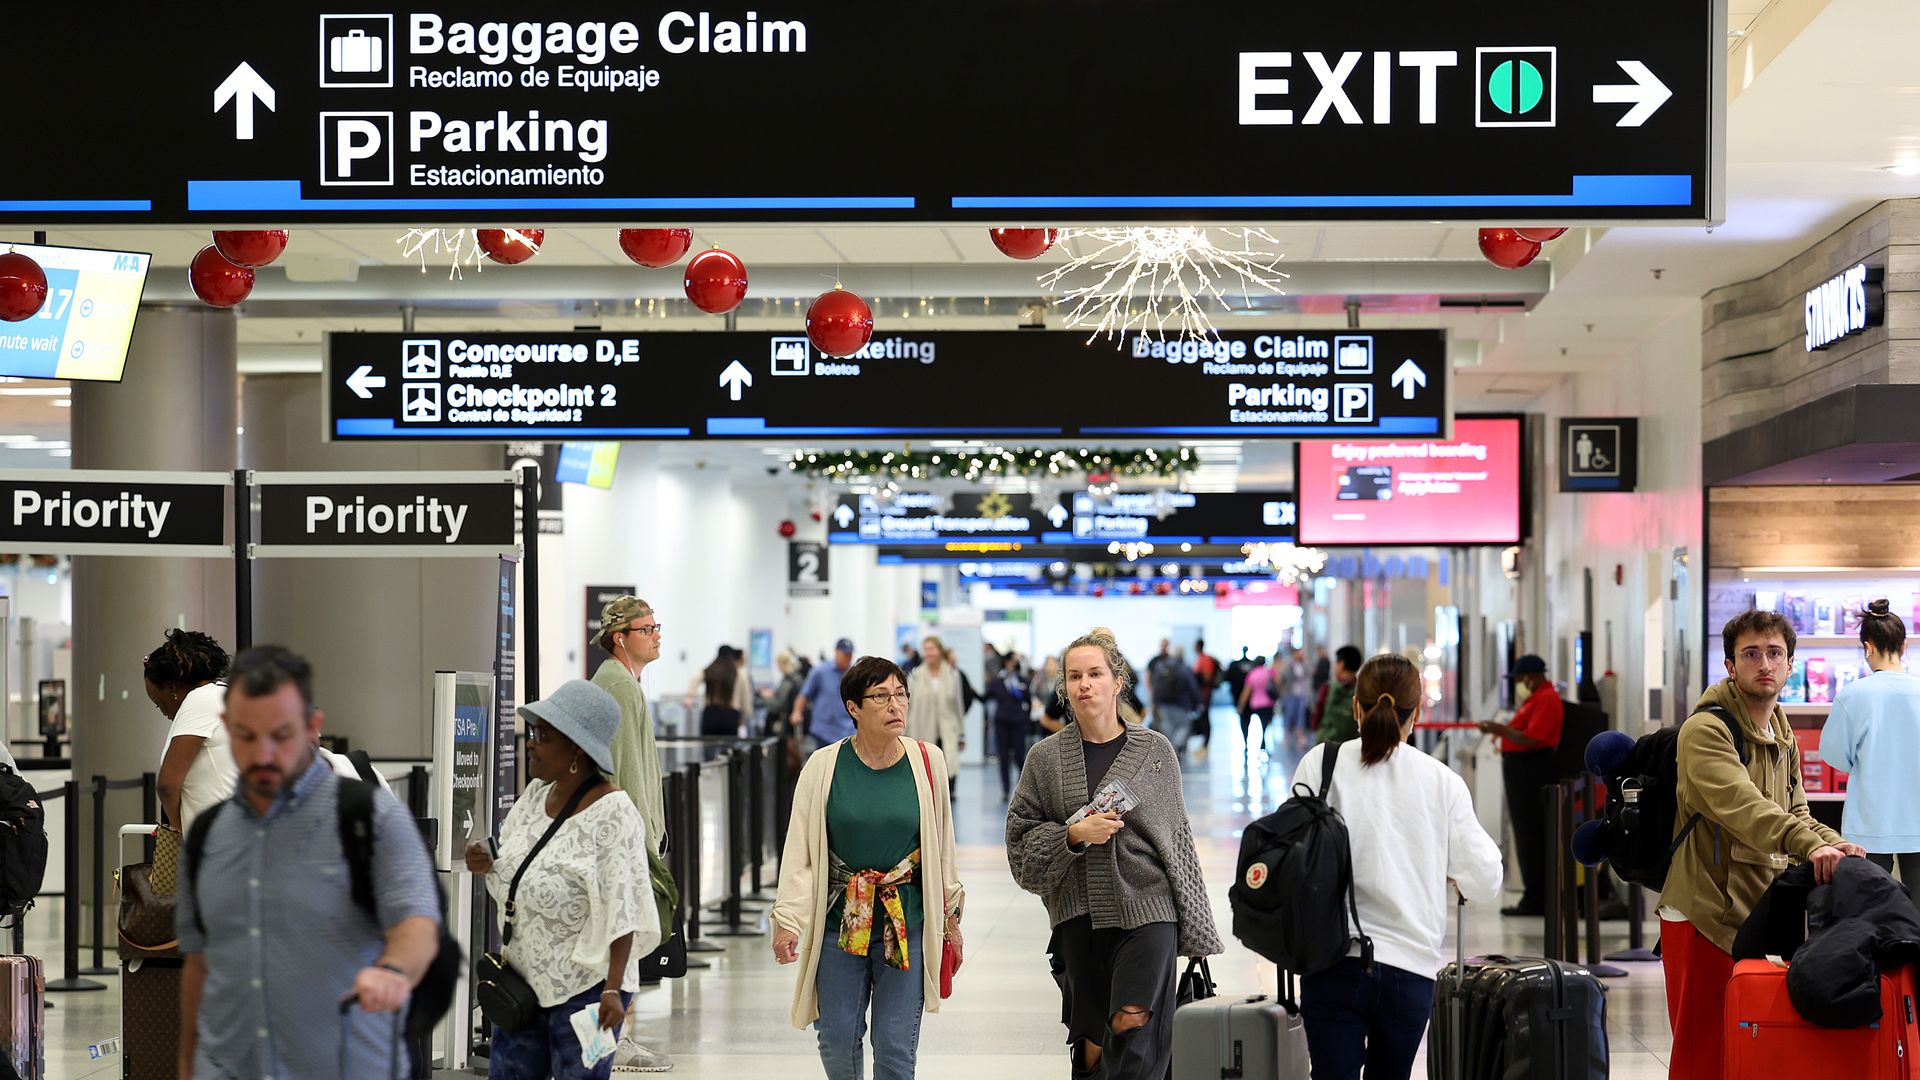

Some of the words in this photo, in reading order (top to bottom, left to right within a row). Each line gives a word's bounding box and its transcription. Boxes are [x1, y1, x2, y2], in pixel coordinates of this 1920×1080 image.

[410, 14, 640, 64] Baggage
[658, 11, 807, 54] Claim
[410, 66, 513, 88] Reclamo
[521, 66, 550, 88] de
[558, 65, 660, 91] Equipaje
[1238, 50, 1458, 126] EXIT
[337, 119, 381, 178] P
[410, 111, 608, 163] Parking
[410, 165, 605, 187] Estacionamiento
[38, 287, 73, 320] 17
[31, 334, 58, 351] wait
[447, 339, 588, 363] Concourse
[596, 339, 640, 367] D,E
[820, 336, 936, 364] keting
[1132, 336, 1247, 364] Baggage
[1253, 335, 1329, 358] Claim
[449, 364, 489, 378] Pasillo
[490, 364, 513, 379] D,E
[815, 362, 860, 376] Boletos
[1203, 362, 1256, 375] Reclamo
[1257, 362, 1275, 375] de
[1275, 362, 1329, 377] Equipaje
[447, 383, 594, 411] Checkpoint
[600, 384, 617, 407] 2
[1228, 383, 1329, 411] Parking
[1342, 387, 1367, 418] P
[448, 408, 491, 422] Control
[493, 408, 510, 422] de
[511, 408, 572, 425] Seguridad
[573, 408, 583, 422] 2
[1230, 409, 1329, 423] Estacionamiento
[13, 489, 171, 538] Priority
[305, 495, 469, 544] Priority
[797, 552, 820, 581] 2
[456, 751, 473, 766] Moved
[474, 752, 480, 766] to
[452, 773, 479, 793] Checkpoint
